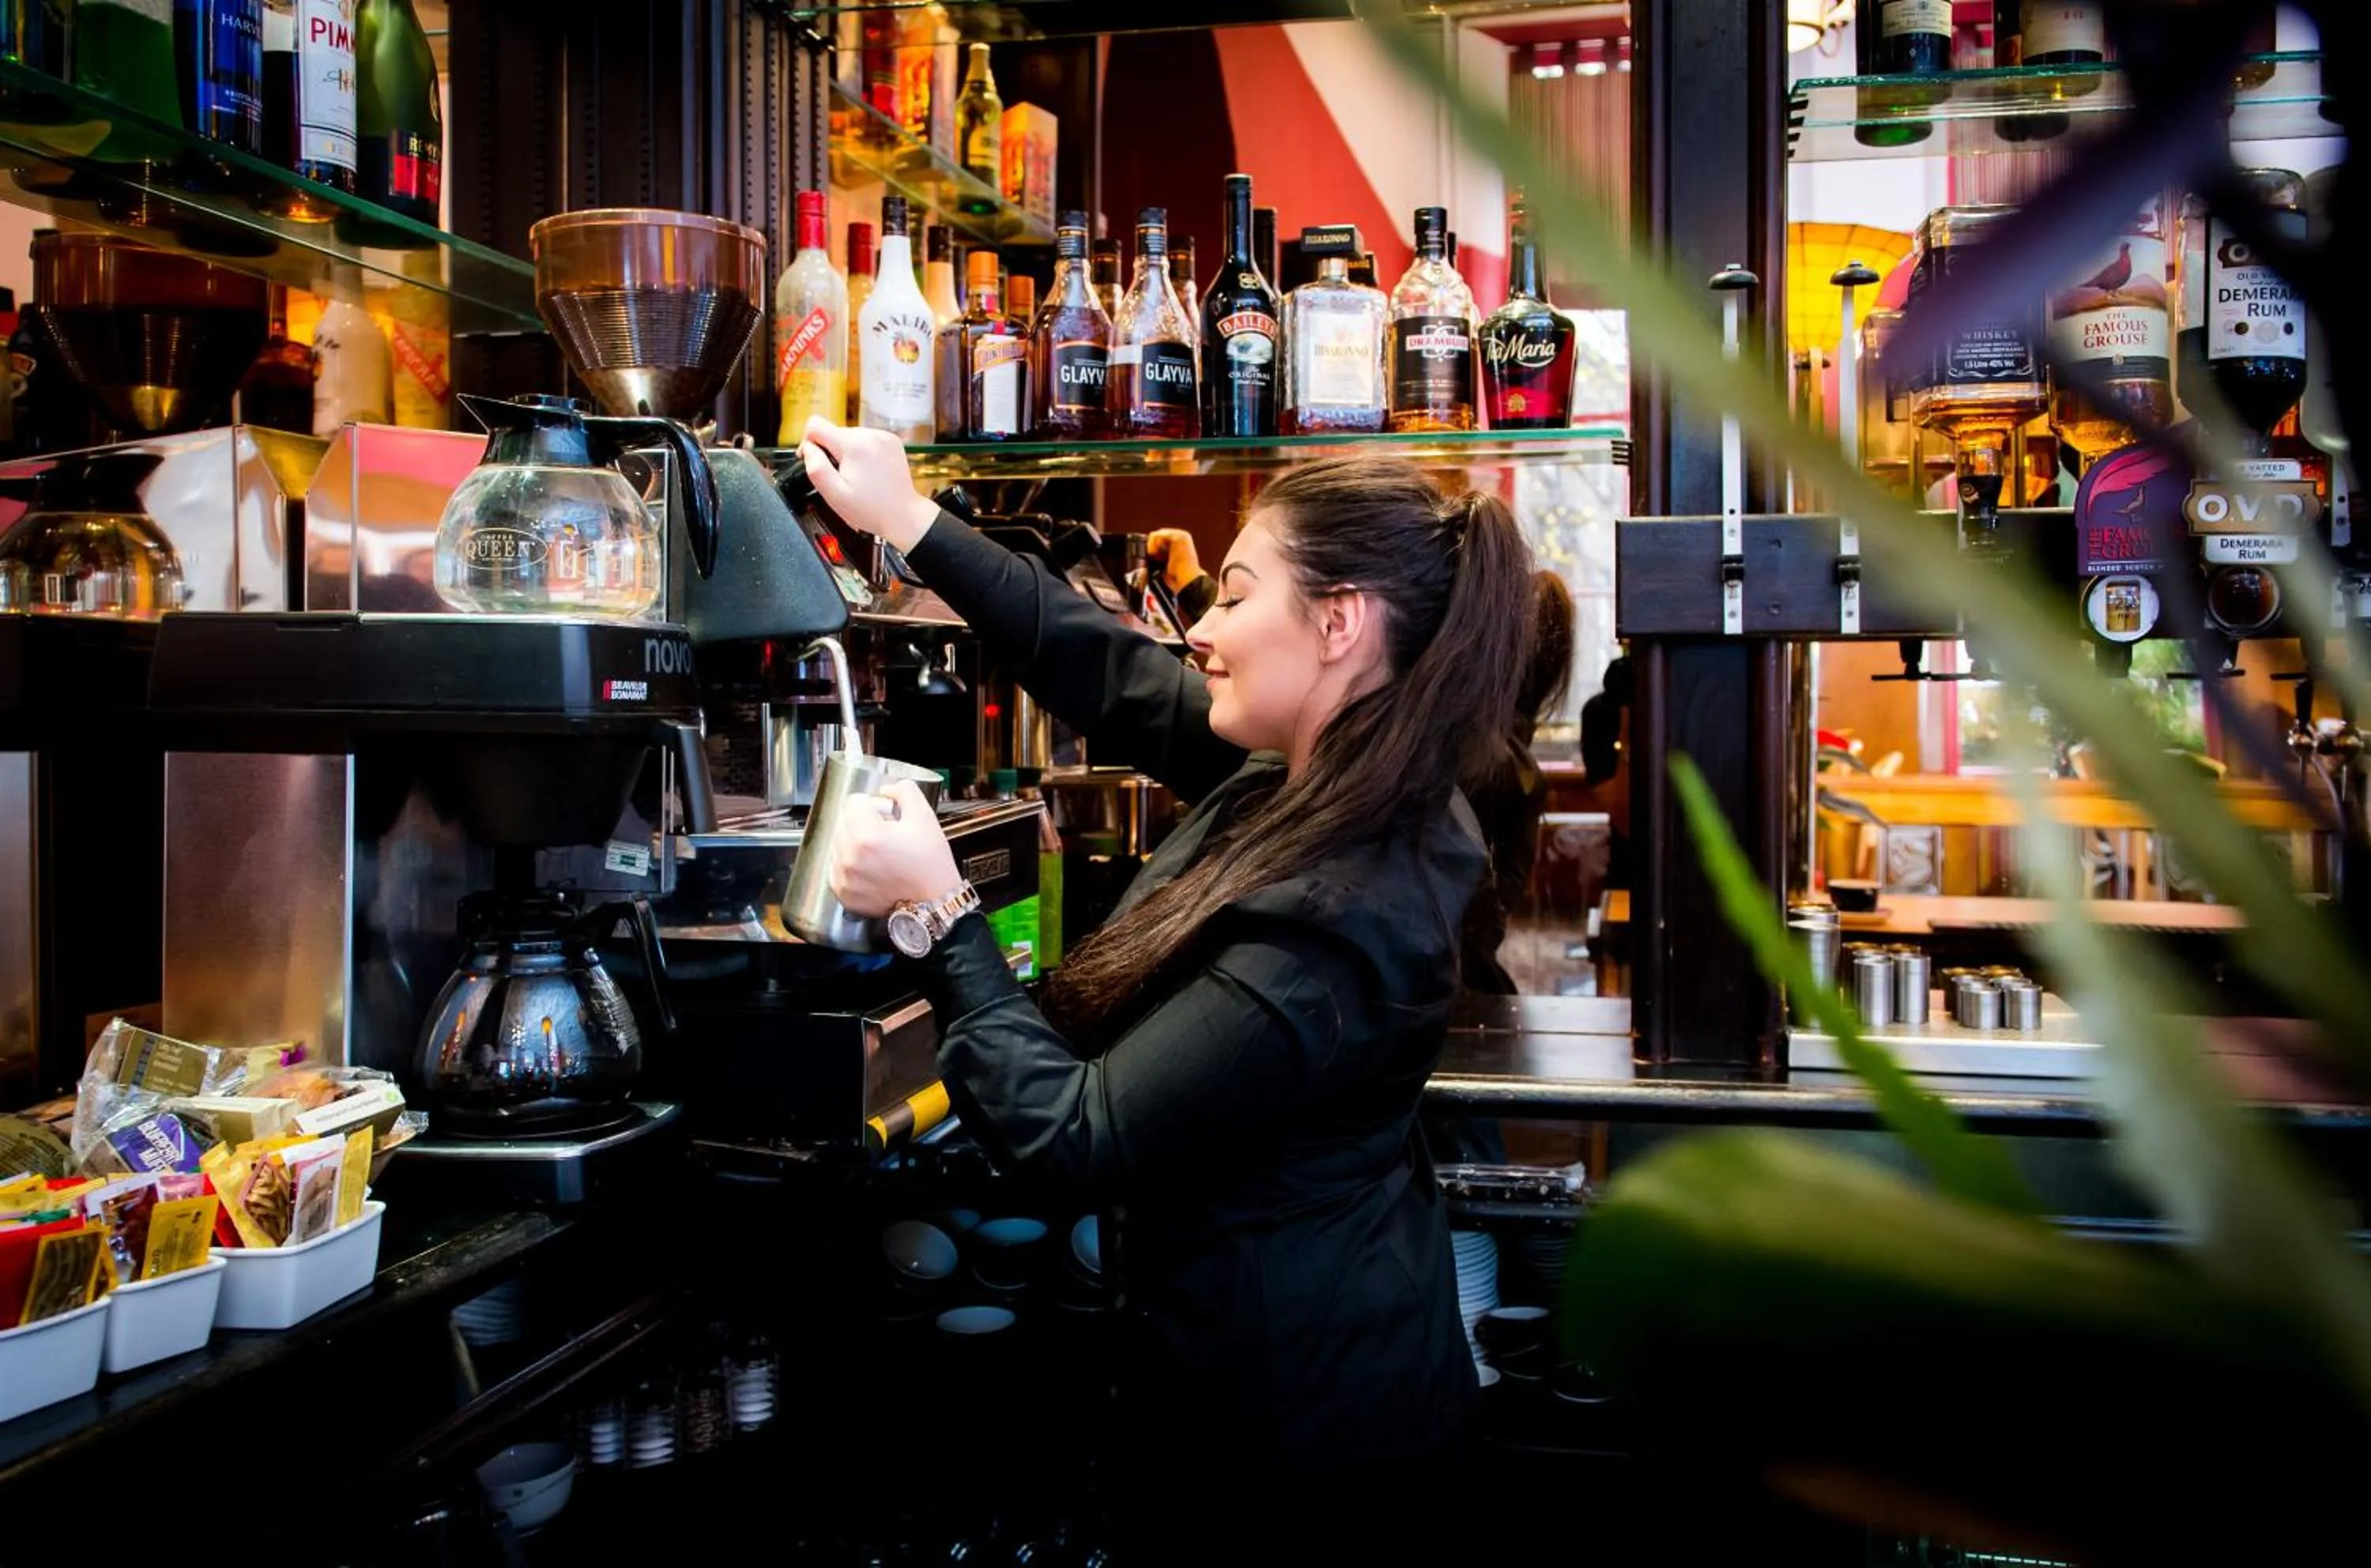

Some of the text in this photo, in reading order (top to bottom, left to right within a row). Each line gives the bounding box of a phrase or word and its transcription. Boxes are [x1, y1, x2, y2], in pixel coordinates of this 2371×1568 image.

[2218, 287, 2302, 303] DEMERA
[2247, 303, 2286, 317] RUM
[1225, 317, 1276, 335] BAILEYS
[2083, 319, 2148, 335] FAMOUS
[1501, 333, 1556, 364] Maria
[2083, 333, 2148, 349] GROUSE
[1061, 365, 1106, 386] GLAYV
[1146, 362, 1193, 383] GLAYVA
[2250, 463, 2286, 472] VATTED
[466, 541, 531, 560] QUEEN
[2220, 538, 2284, 549] DEMERARA
[2238, 549, 2266, 560] RUM
[645, 639, 692, 674] novo
